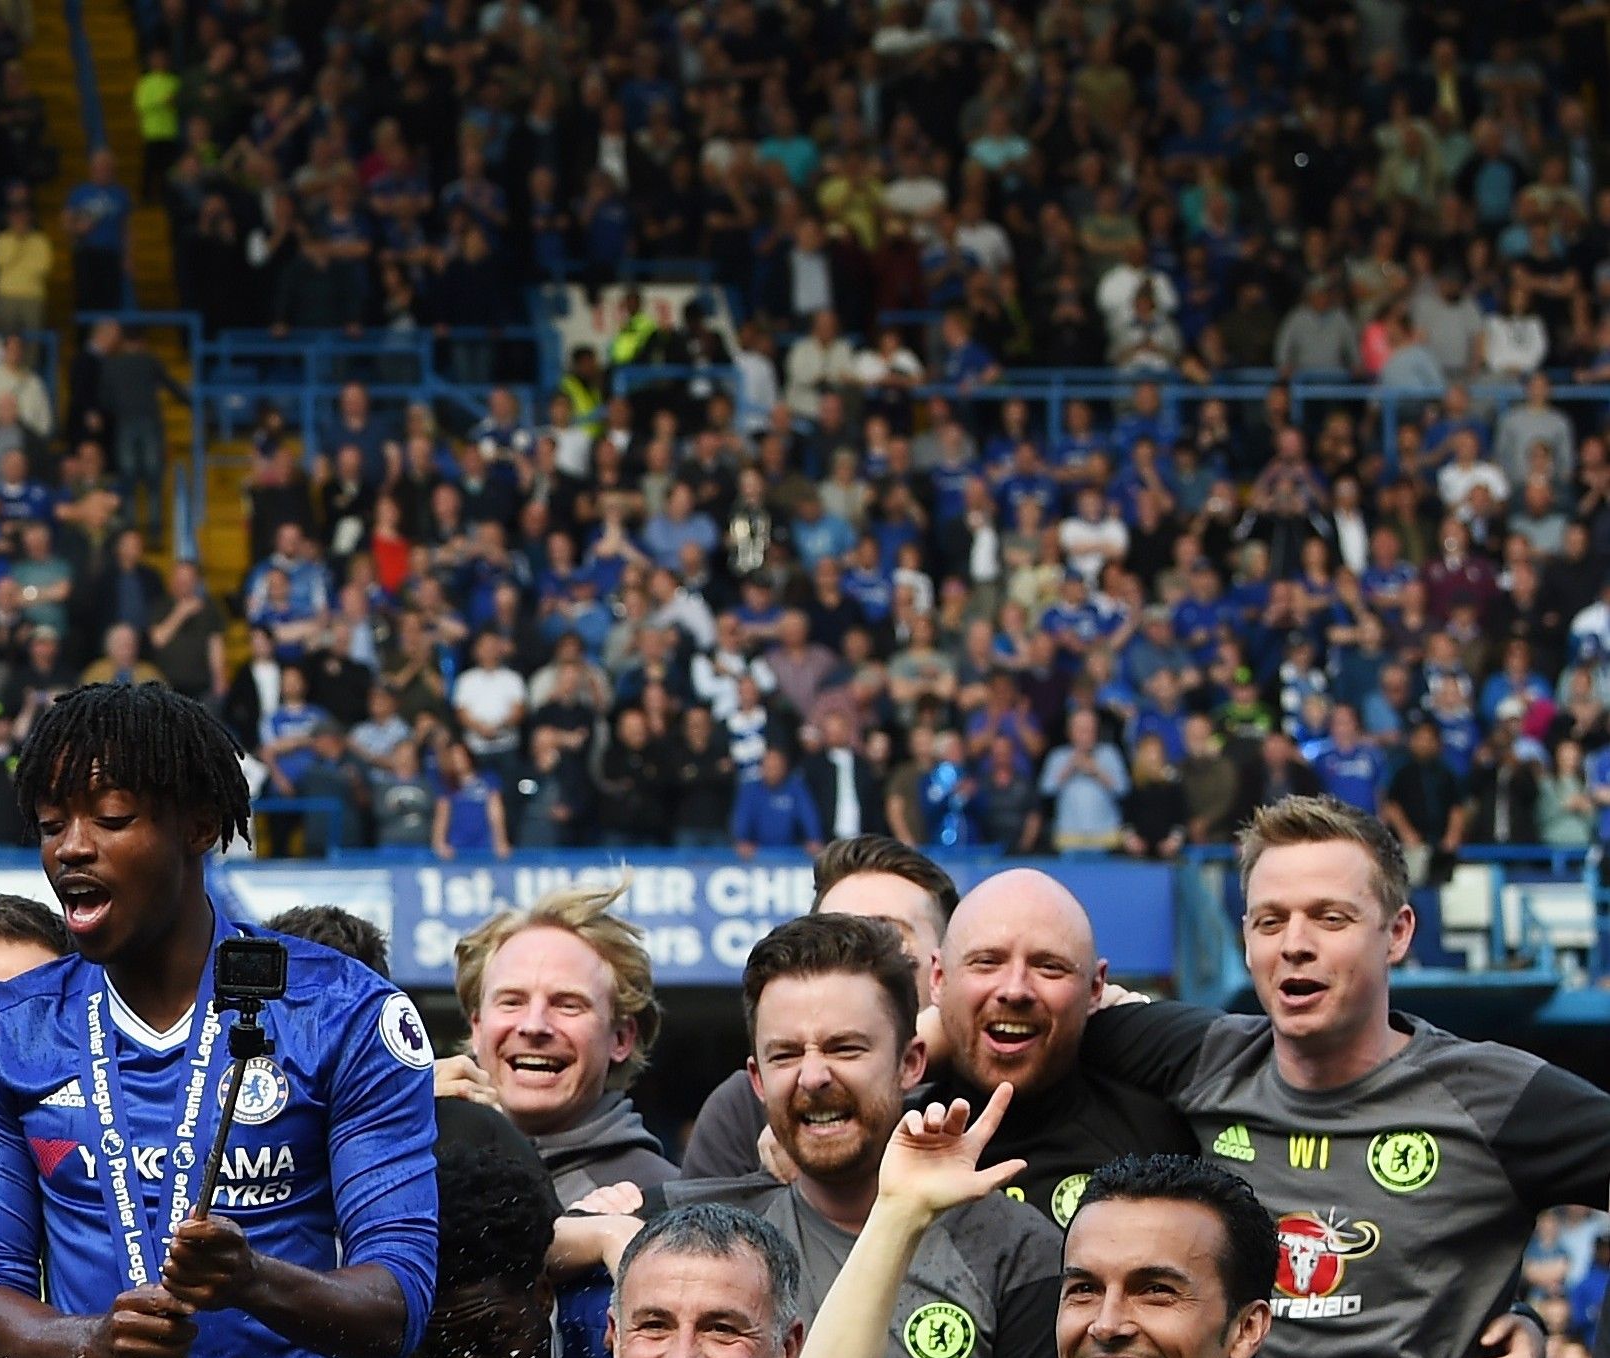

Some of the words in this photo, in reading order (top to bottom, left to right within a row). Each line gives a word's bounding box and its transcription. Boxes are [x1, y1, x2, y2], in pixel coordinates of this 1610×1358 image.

[88, 992, 106, 1056] Premier
[190, 1000, 221, 1068] Leagu
[90, 1058, 114, 1126] League
[177, 1069, 207, 1139] Premier
[108, 1158, 137, 1234] Premier
[124, 1230, 150, 1287] Leag
[1270, 1291, 1363, 1319] rabao
